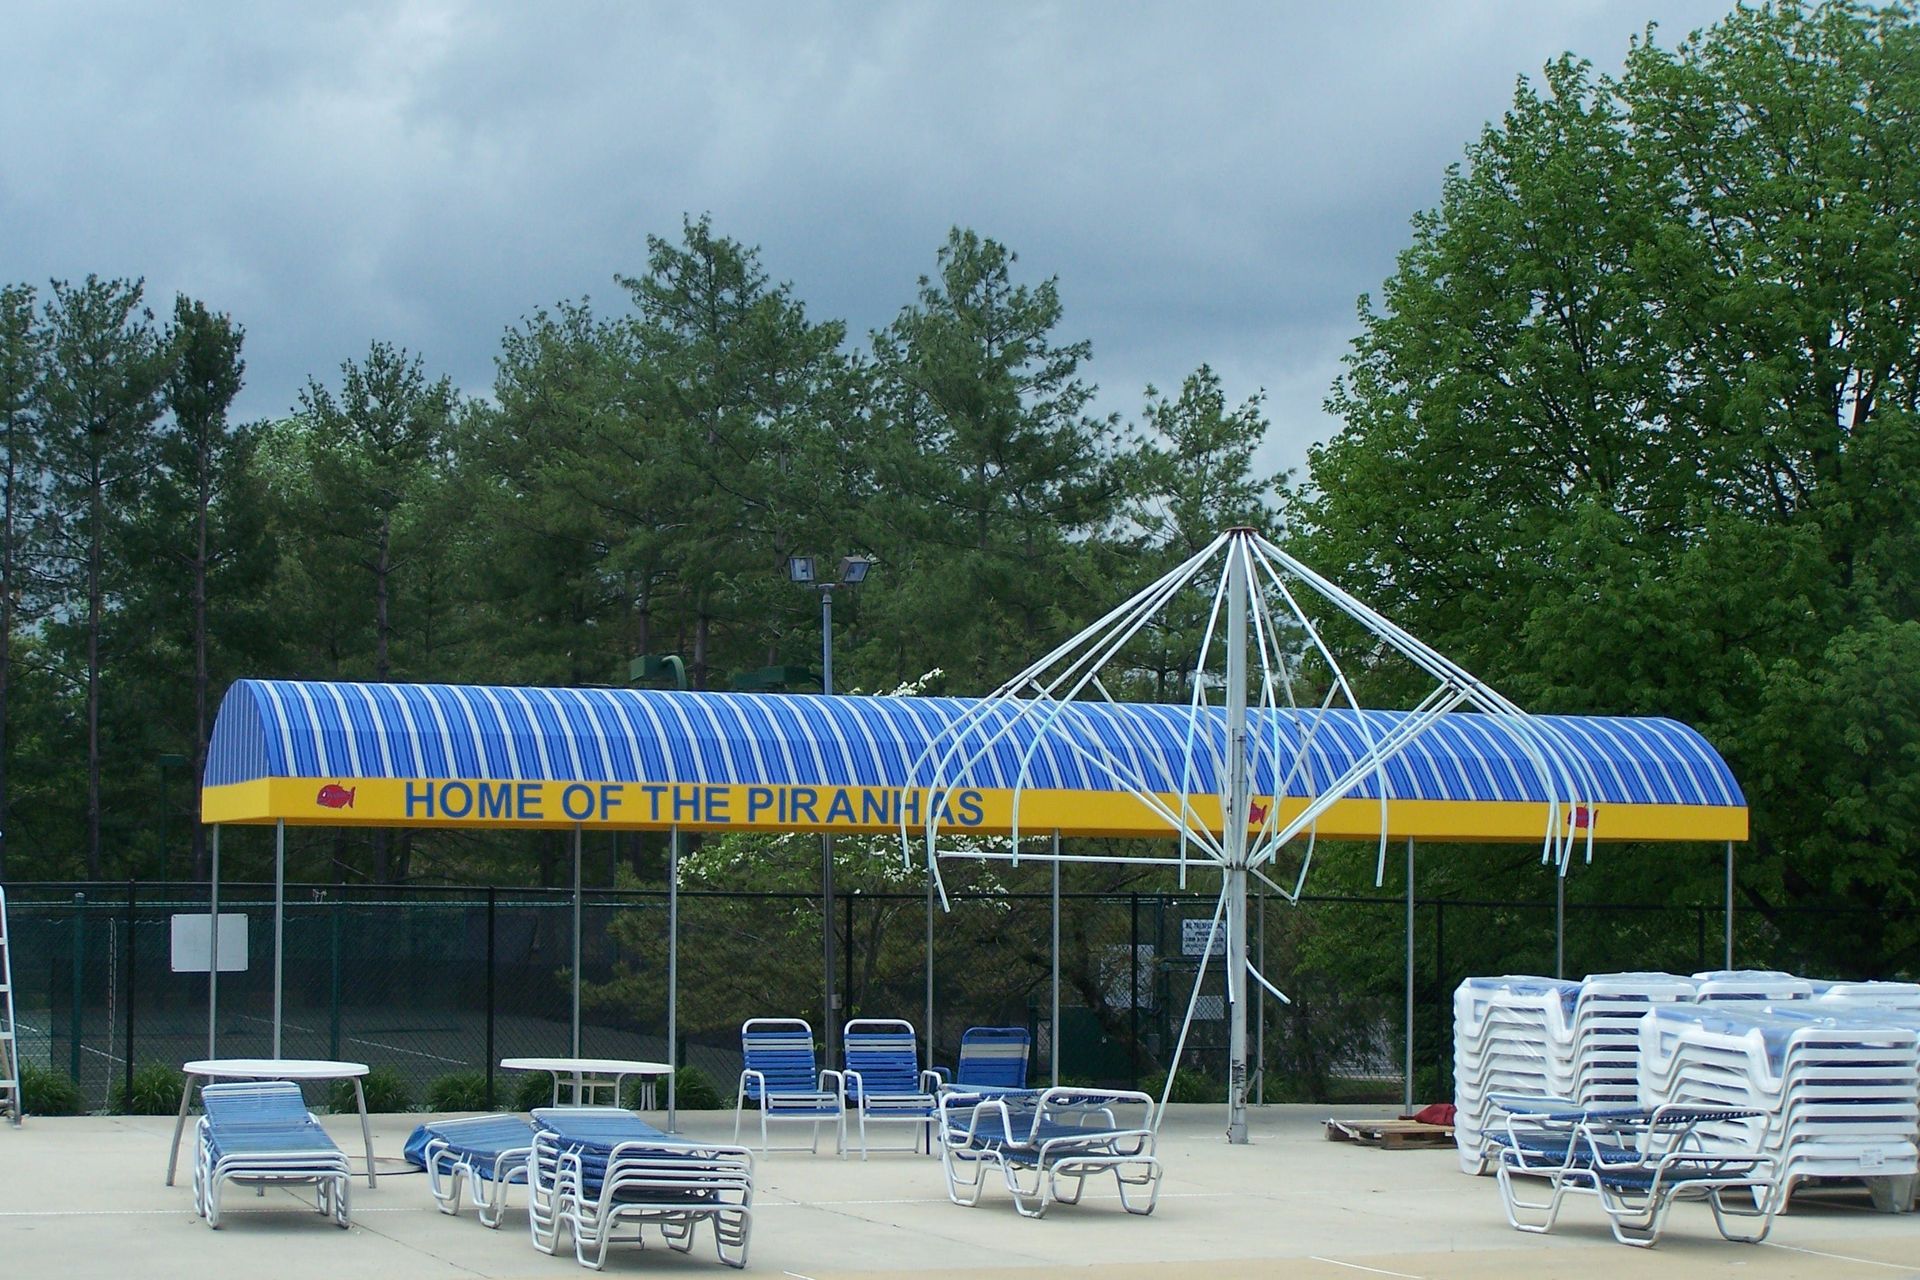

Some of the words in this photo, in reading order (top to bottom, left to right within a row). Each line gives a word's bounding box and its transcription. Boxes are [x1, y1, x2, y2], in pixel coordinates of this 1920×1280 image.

[405, 781, 544, 819] HOME
[562, 783, 624, 820] OF
[641, 785, 731, 823] THE
[748, 787, 984, 826] PIRANHAS
